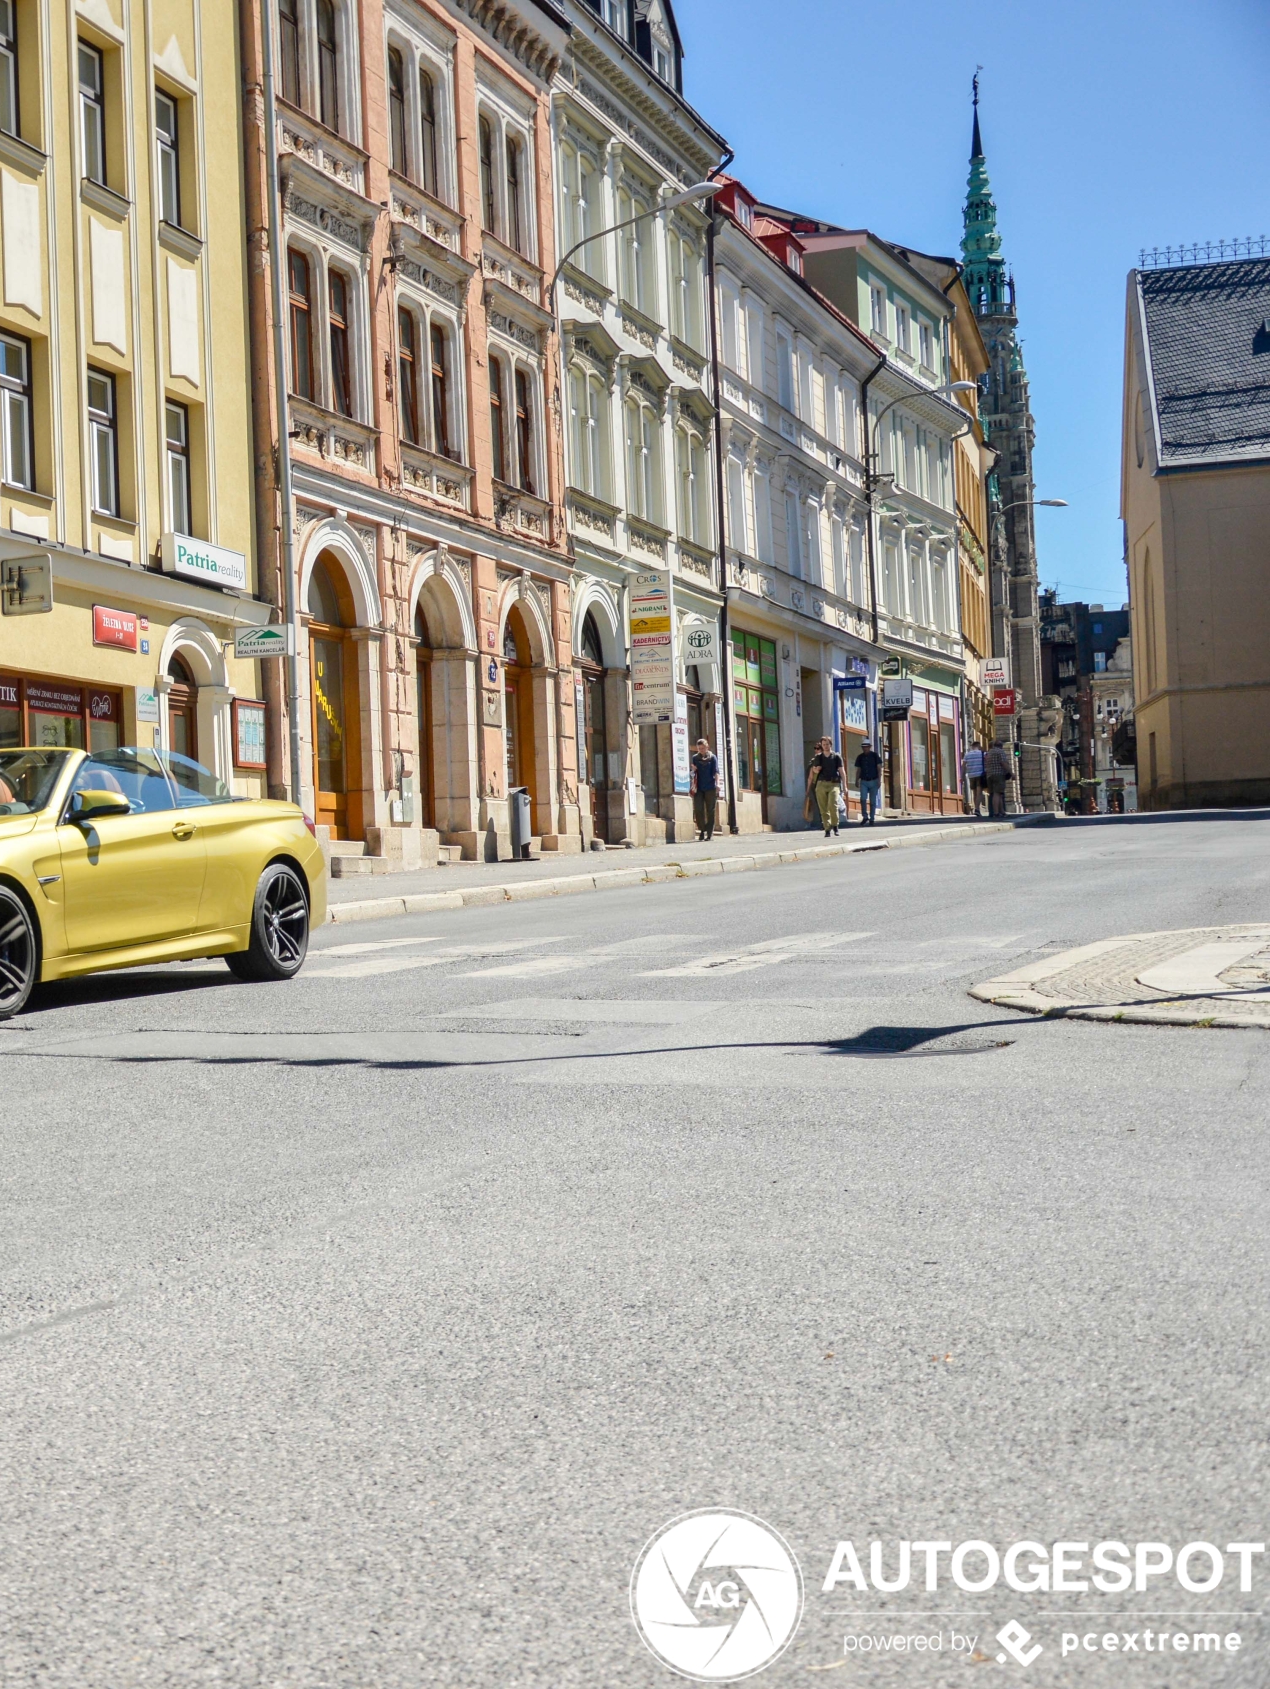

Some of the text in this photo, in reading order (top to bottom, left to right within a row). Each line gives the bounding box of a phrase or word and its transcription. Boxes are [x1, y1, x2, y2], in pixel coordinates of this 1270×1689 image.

[177, 545, 244, 582] Patria reality
[237, 638, 266, 647] Patria
[687, 649, 713, 660] ADRA
[886, 697, 911, 705] KVELB
